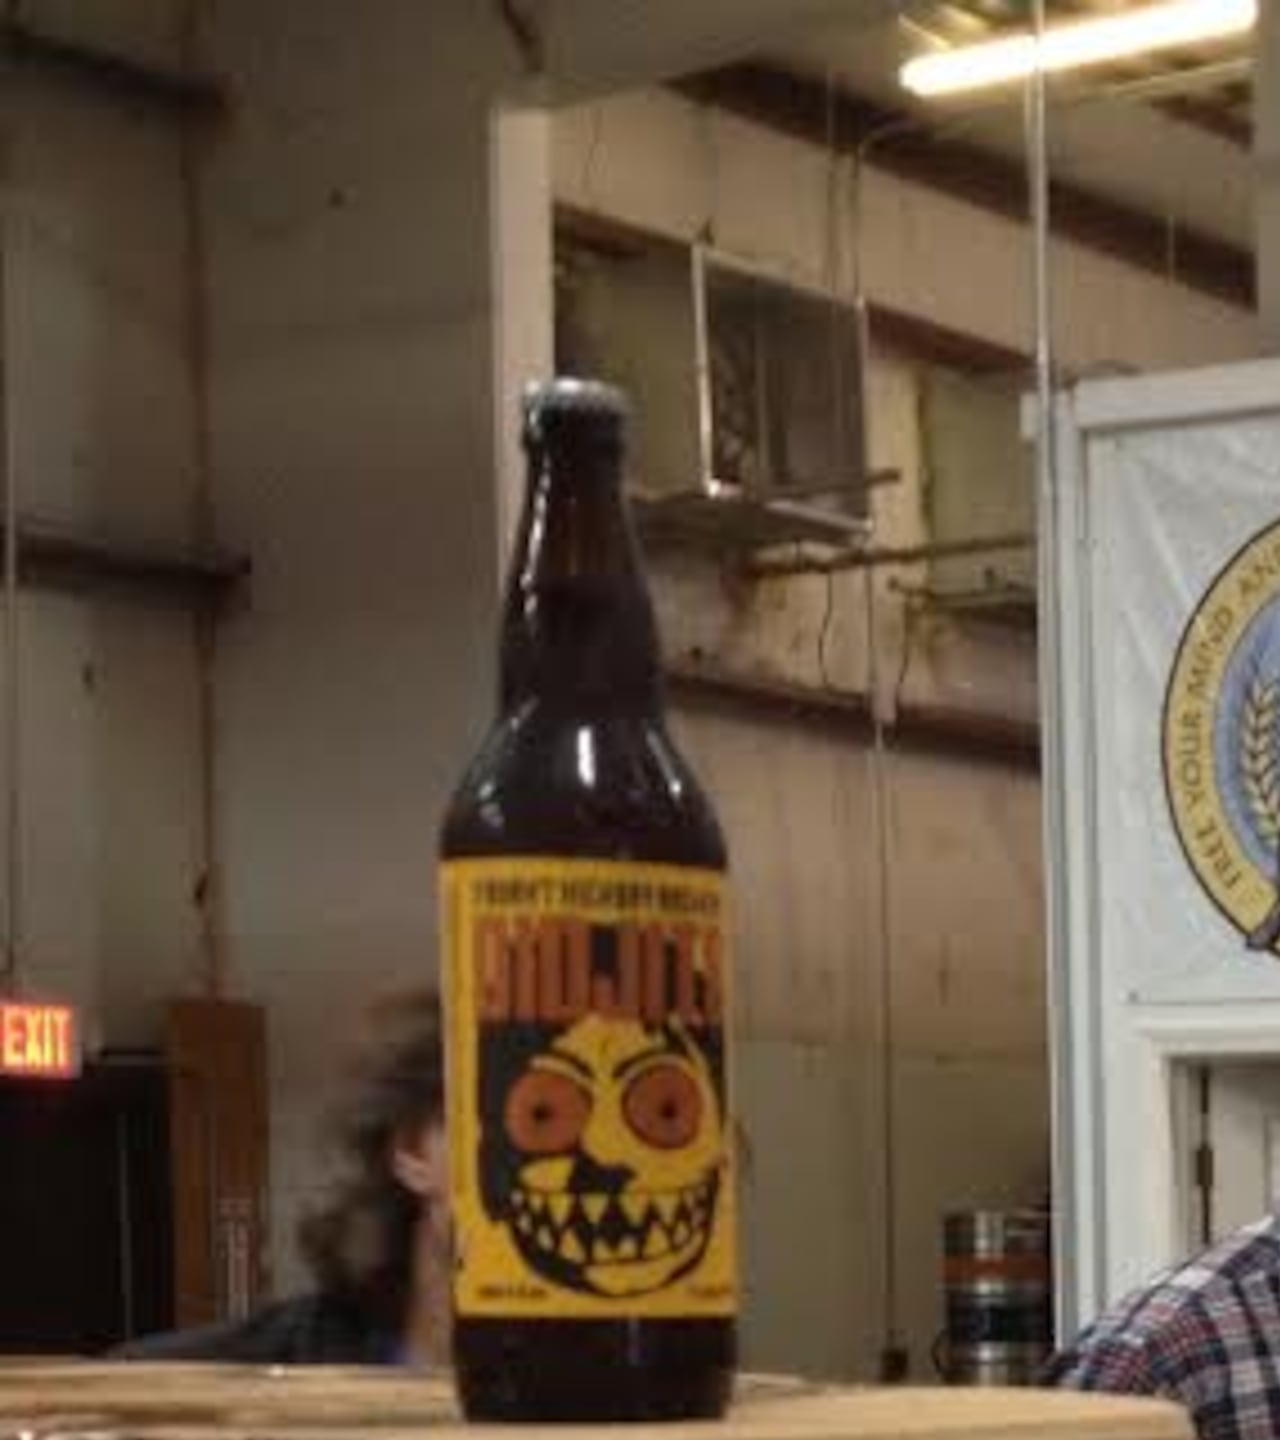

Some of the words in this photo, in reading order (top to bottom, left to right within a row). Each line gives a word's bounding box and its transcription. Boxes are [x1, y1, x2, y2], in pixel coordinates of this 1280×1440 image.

[1187, 606, 1234, 694] MIND
[1177, 710, 1207, 812] YOUR
[2, 1004, 74, 1068] EXIT
